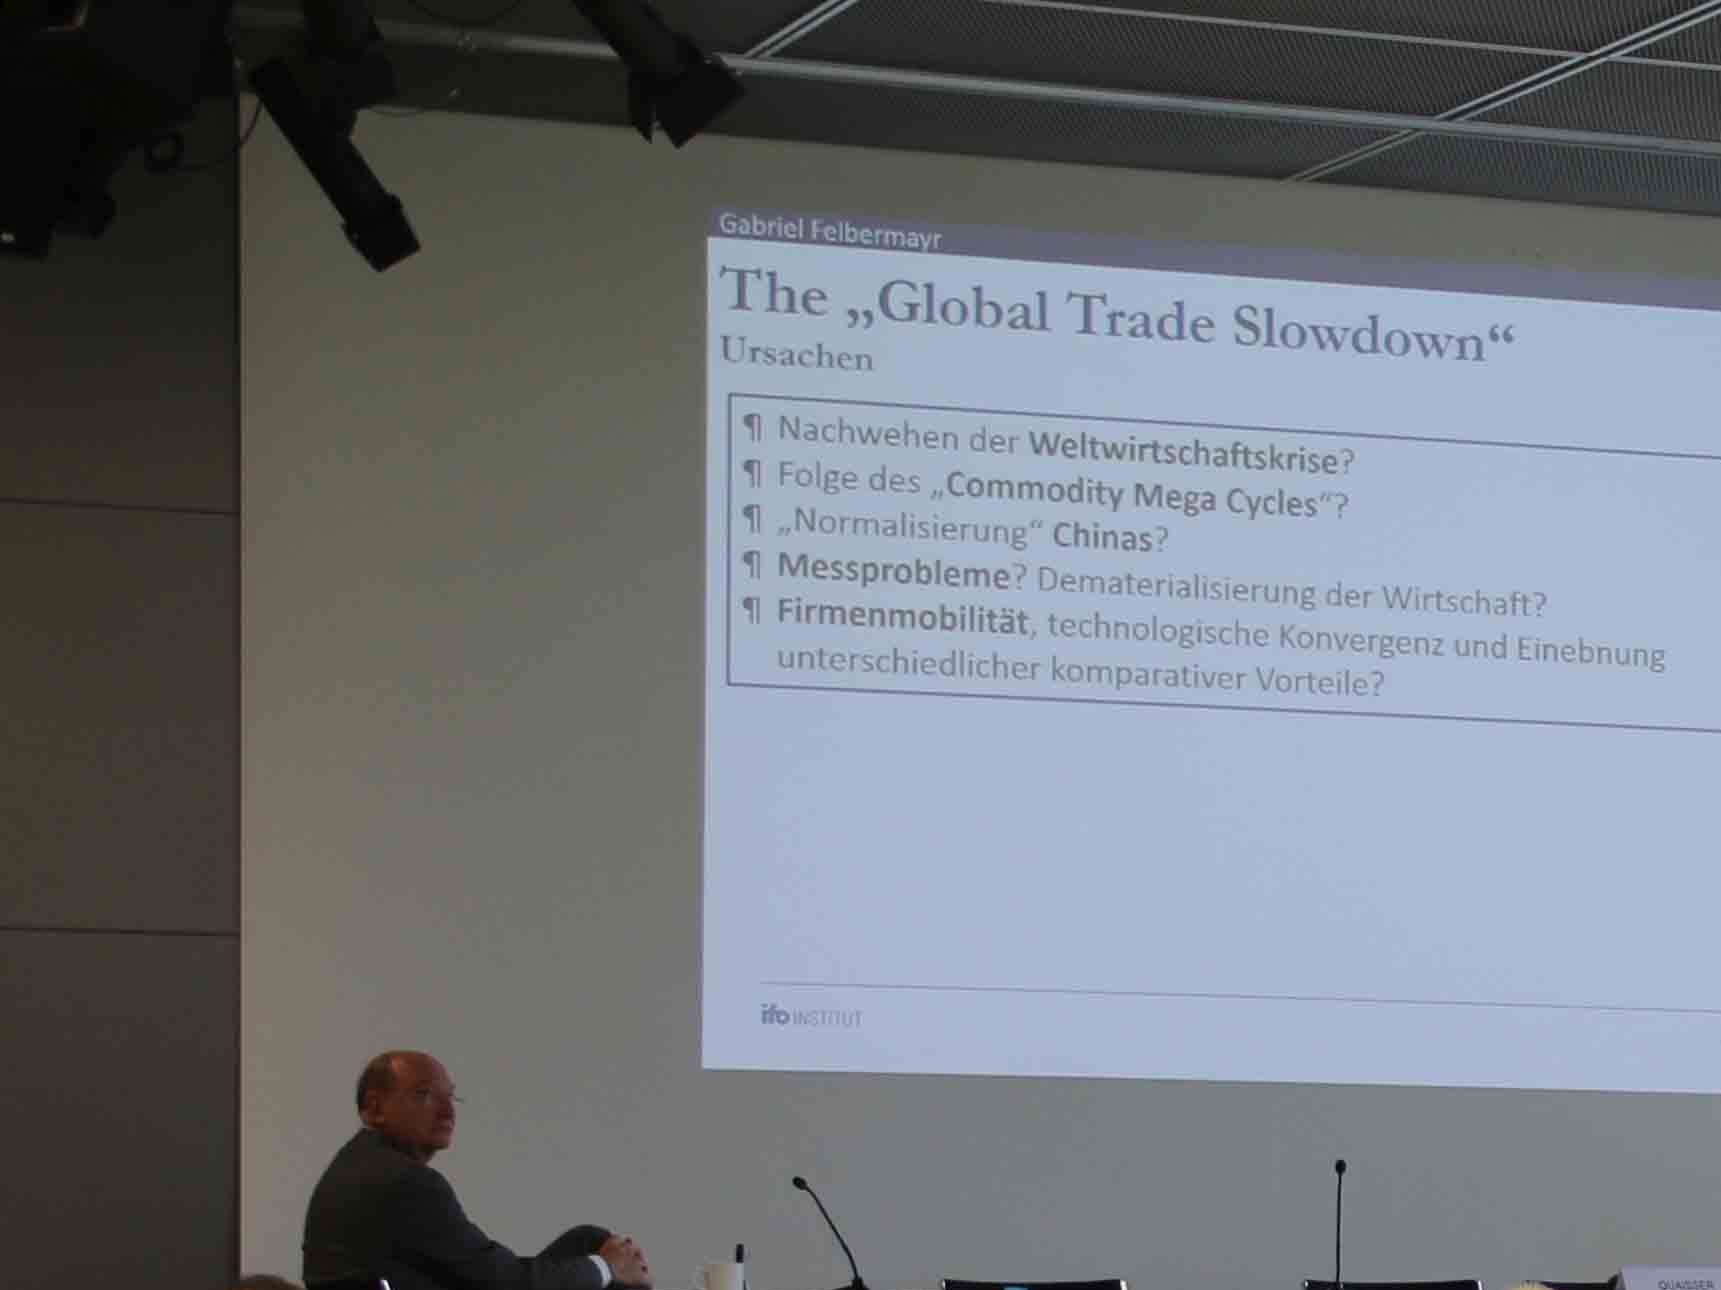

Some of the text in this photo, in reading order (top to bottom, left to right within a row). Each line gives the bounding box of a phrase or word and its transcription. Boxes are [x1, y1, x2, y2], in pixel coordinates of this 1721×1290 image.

[719, 212, 942, 253] Gabriel Felbermayr
[719, 266, 829, 317] The
[1065, 290, 1216, 344] Trade
[719, 335, 874, 372] Ursachen
[778, 415, 1355, 476] Nachwehen der Weltwirtschaftskrise?
[778, 460, 859, 496] Folge
[868, 465, 922, 495] des
[1133, 483, 1217, 518] Mega
[1052, 521, 1169, 554] Chinas?
[778, 552, 1548, 618] Messprobleme? Dematerialisierung der Wirtschaft?
[778, 597, 1667, 674] Firmenmobilität, technologische Konvergenz und Einebnung
[776, 645, 1386, 698] unterschiedlicher komparativer Vorteile?
[760, 1002, 790, 1025] ifo
